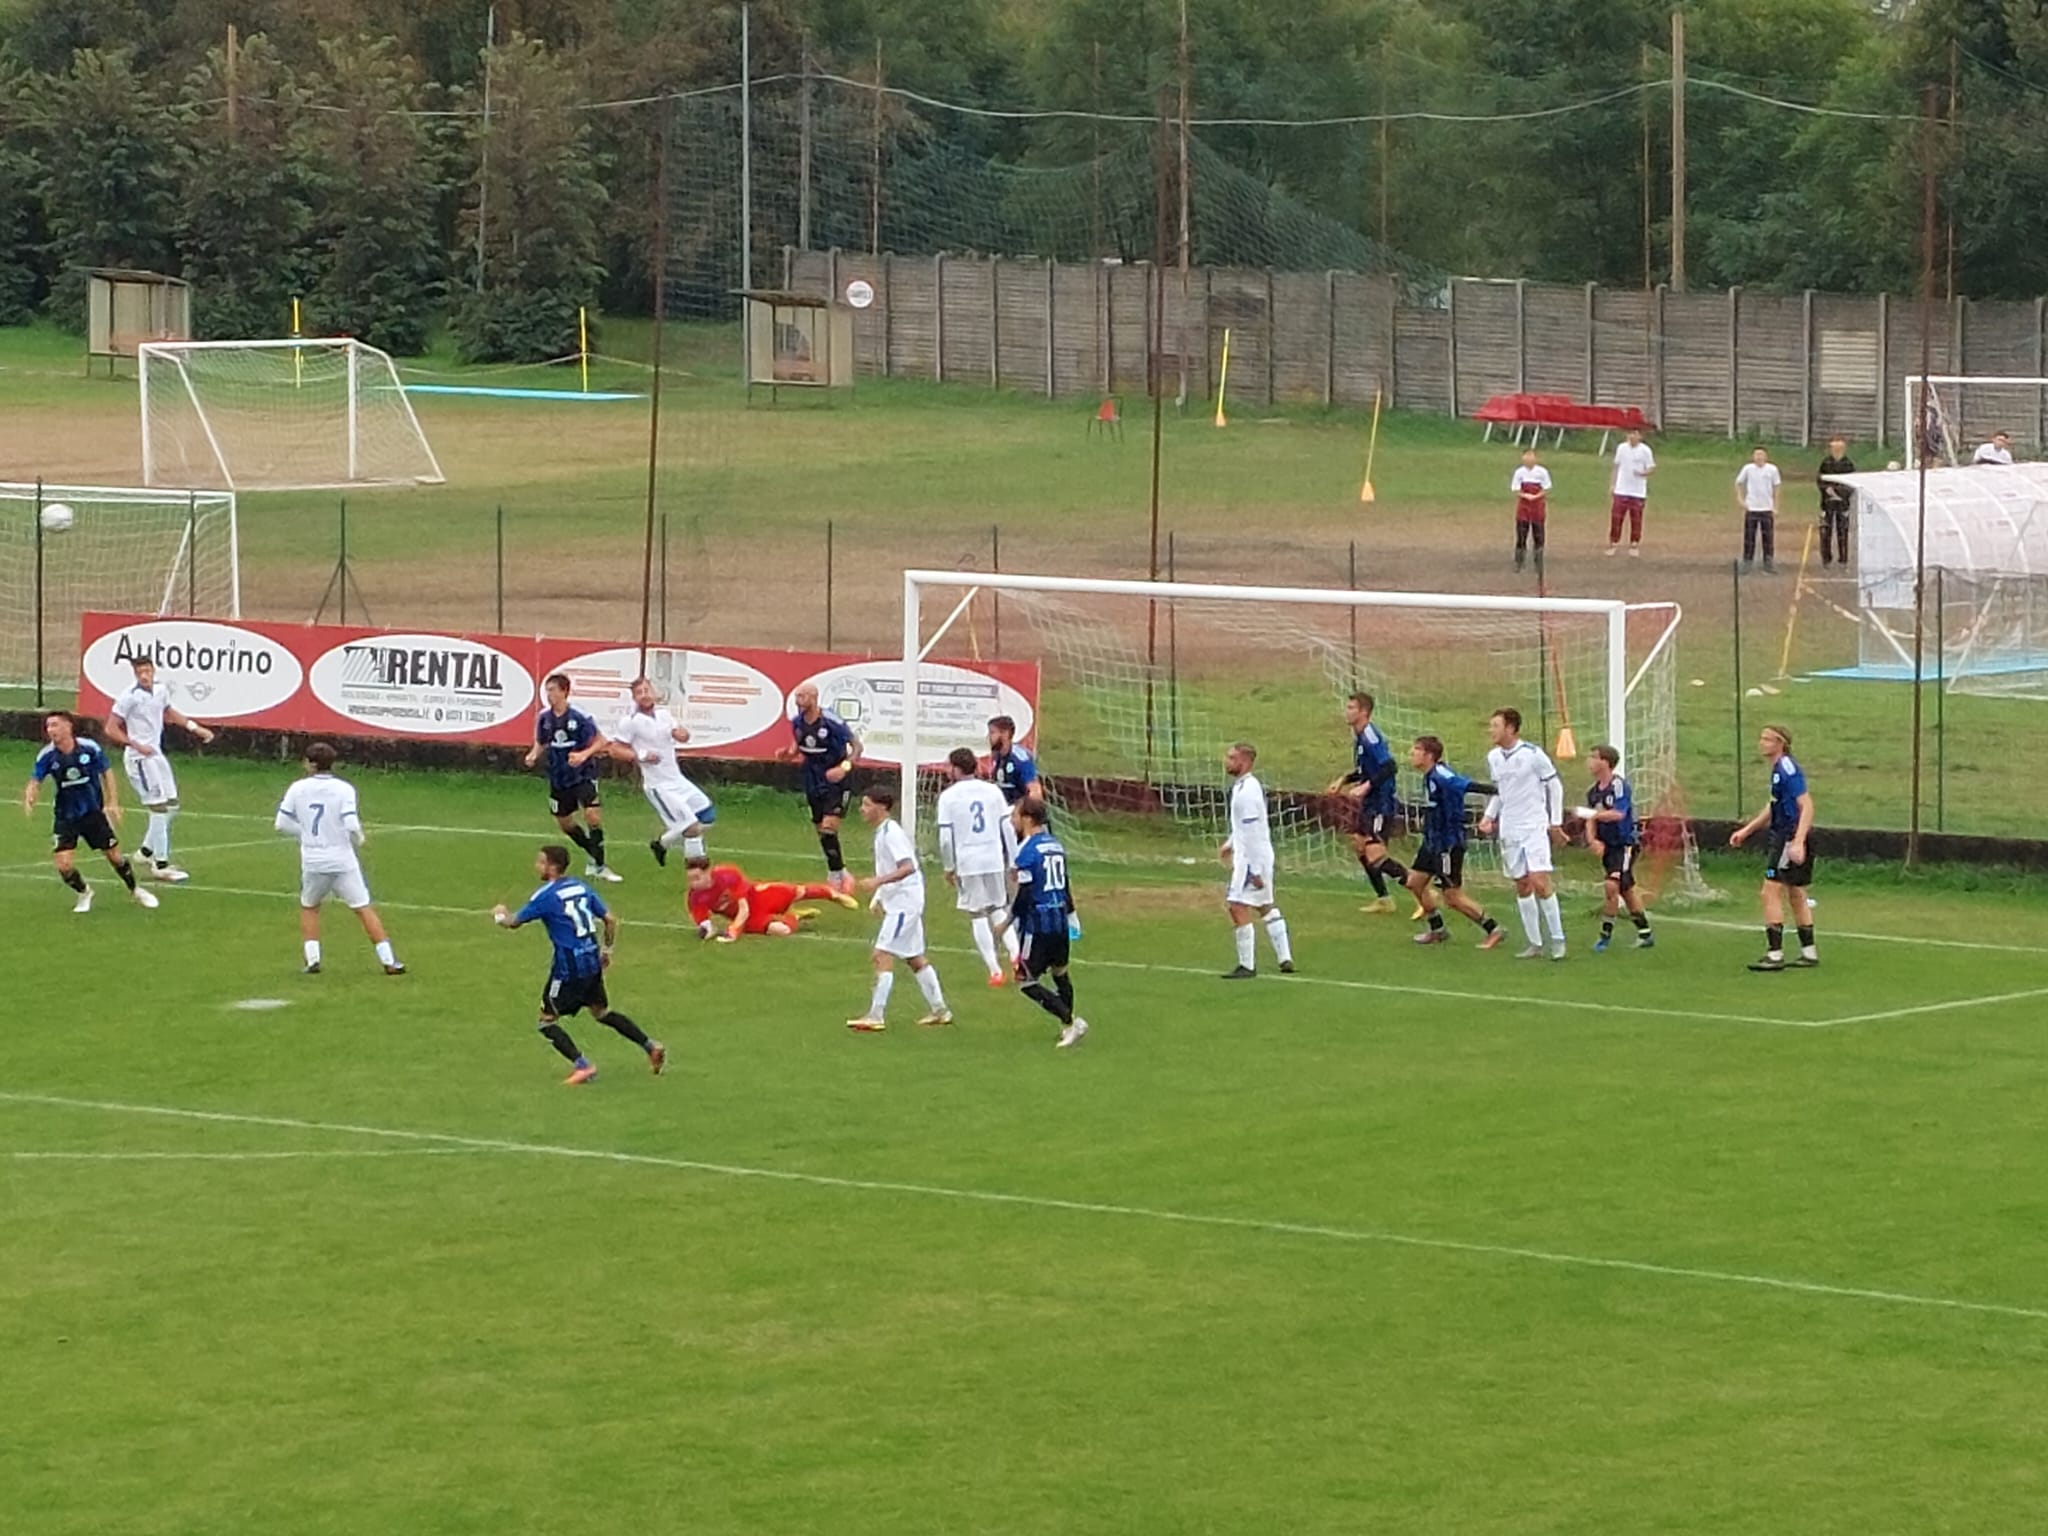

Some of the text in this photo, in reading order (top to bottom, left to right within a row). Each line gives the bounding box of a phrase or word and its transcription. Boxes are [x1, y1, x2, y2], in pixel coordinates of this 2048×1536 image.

[114, 632, 273, 676] Autotorino
[309, 803, 325, 836] 7
[970, 800, 985, 833] 3
[1043, 854, 1066, 892] 10
